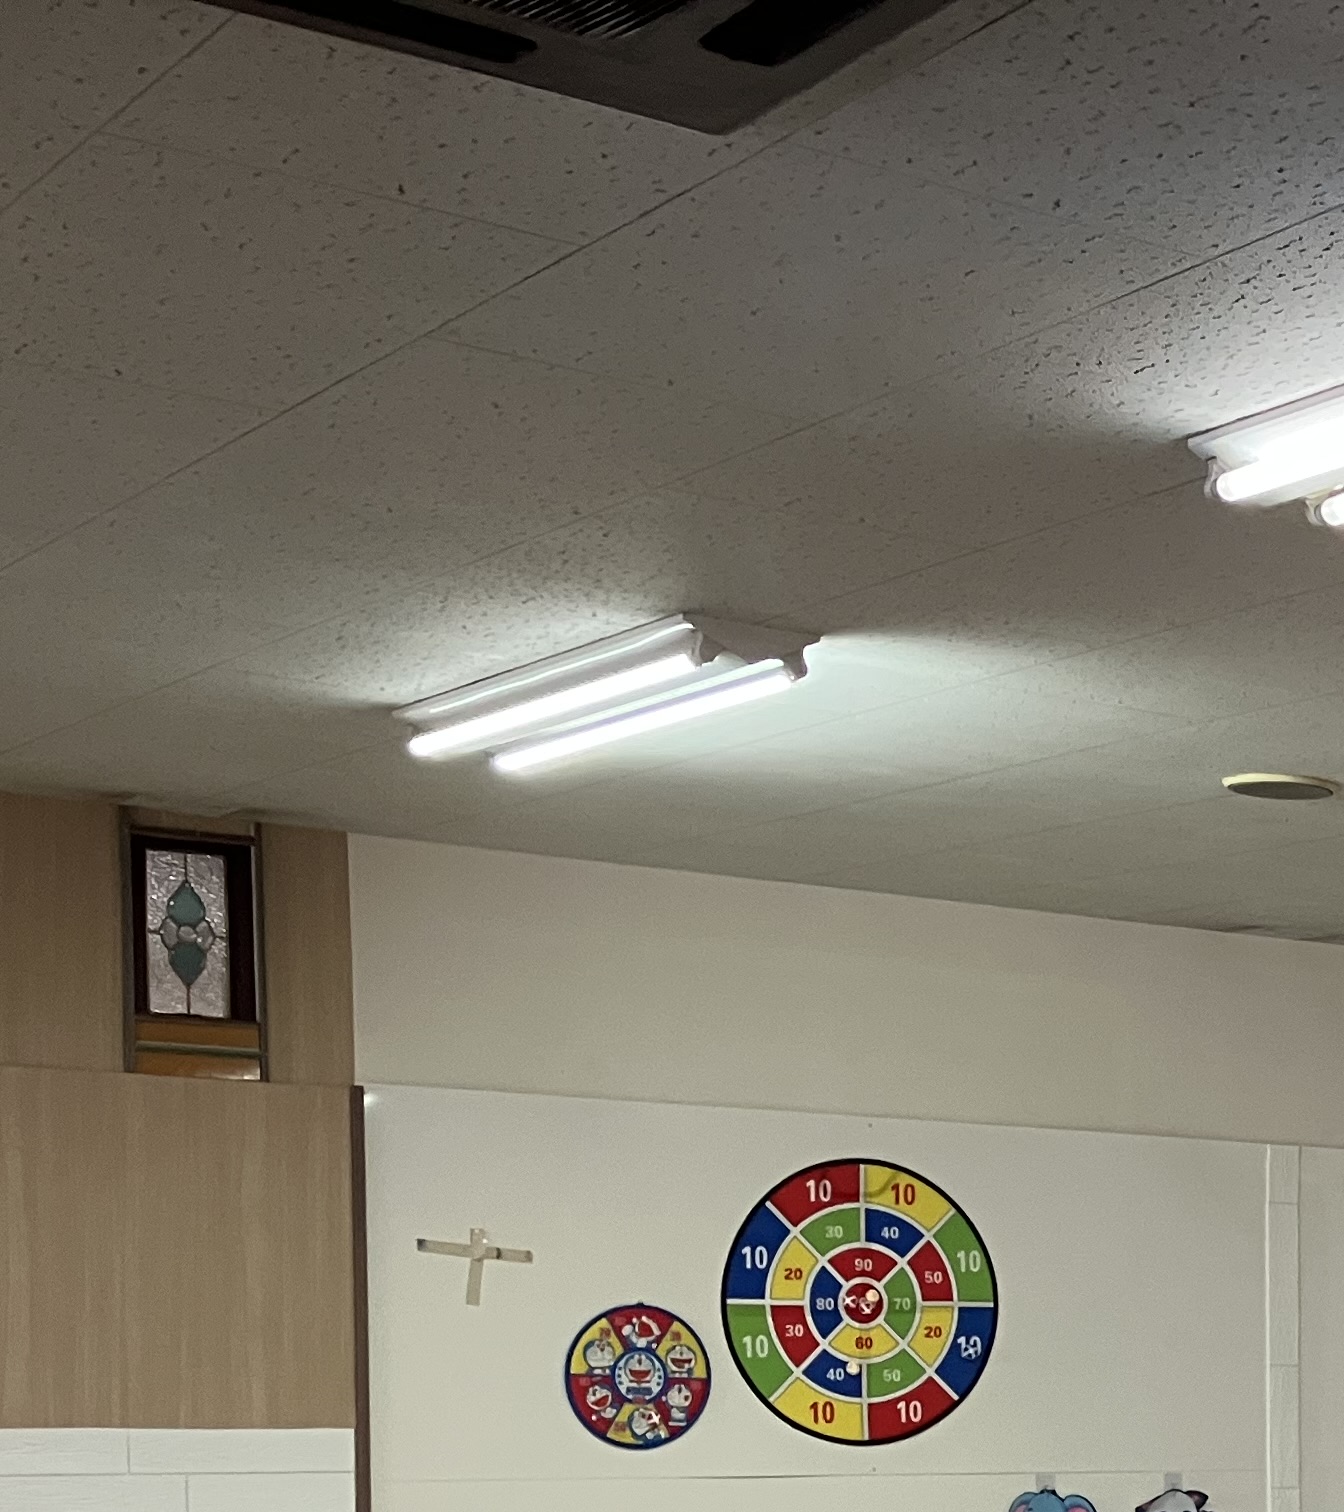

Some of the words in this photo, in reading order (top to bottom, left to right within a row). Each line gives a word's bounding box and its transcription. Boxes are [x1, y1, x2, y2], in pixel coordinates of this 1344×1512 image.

[806, 1179, 832, 1202] 10
[890, 1183, 916, 1206] 10
[825, 1226, 843, 1239] 30
[881, 1226, 899, 1239] 40
[741, 1246, 768, 1270] 10
[957, 1250, 981, 1273] 10
[854, 1259, 873, 1272] 90
[784, 1268, 803, 1280] 20
[924, 1271, 943, 1284] 50
[816, 1298, 835, 1311] 80
[894, 1298, 911, 1310] 70
[785, 1325, 804, 1337] 30
[924, 1326, 942, 1338] 20
[742, 1335, 769, 1358] 10
[855, 1336, 873, 1350] 60
[826, 1368, 845, 1381] 40
[883, 1369, 901, 1382] 50
[809, 1401, 835, 1424] 10
[896, 1400, 922, 1423] 10
